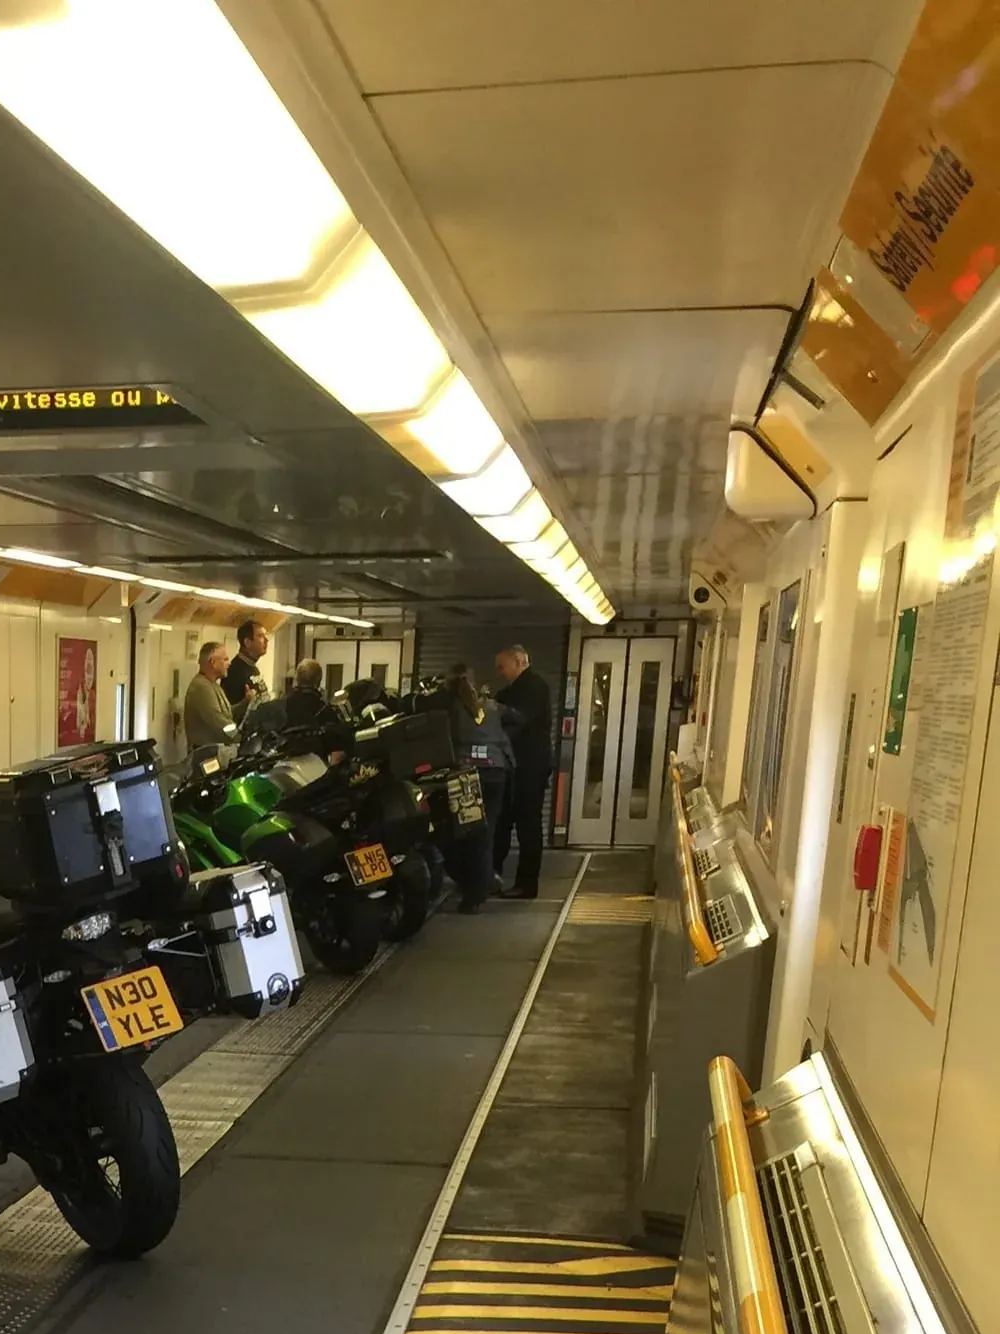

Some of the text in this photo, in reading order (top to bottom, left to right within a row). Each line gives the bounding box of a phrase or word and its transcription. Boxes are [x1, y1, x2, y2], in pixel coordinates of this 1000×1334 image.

[111, 389, 141, 407] ou
[355, 848, 385, 867] LN15
[117, 1004, 171, 1038] YLE
